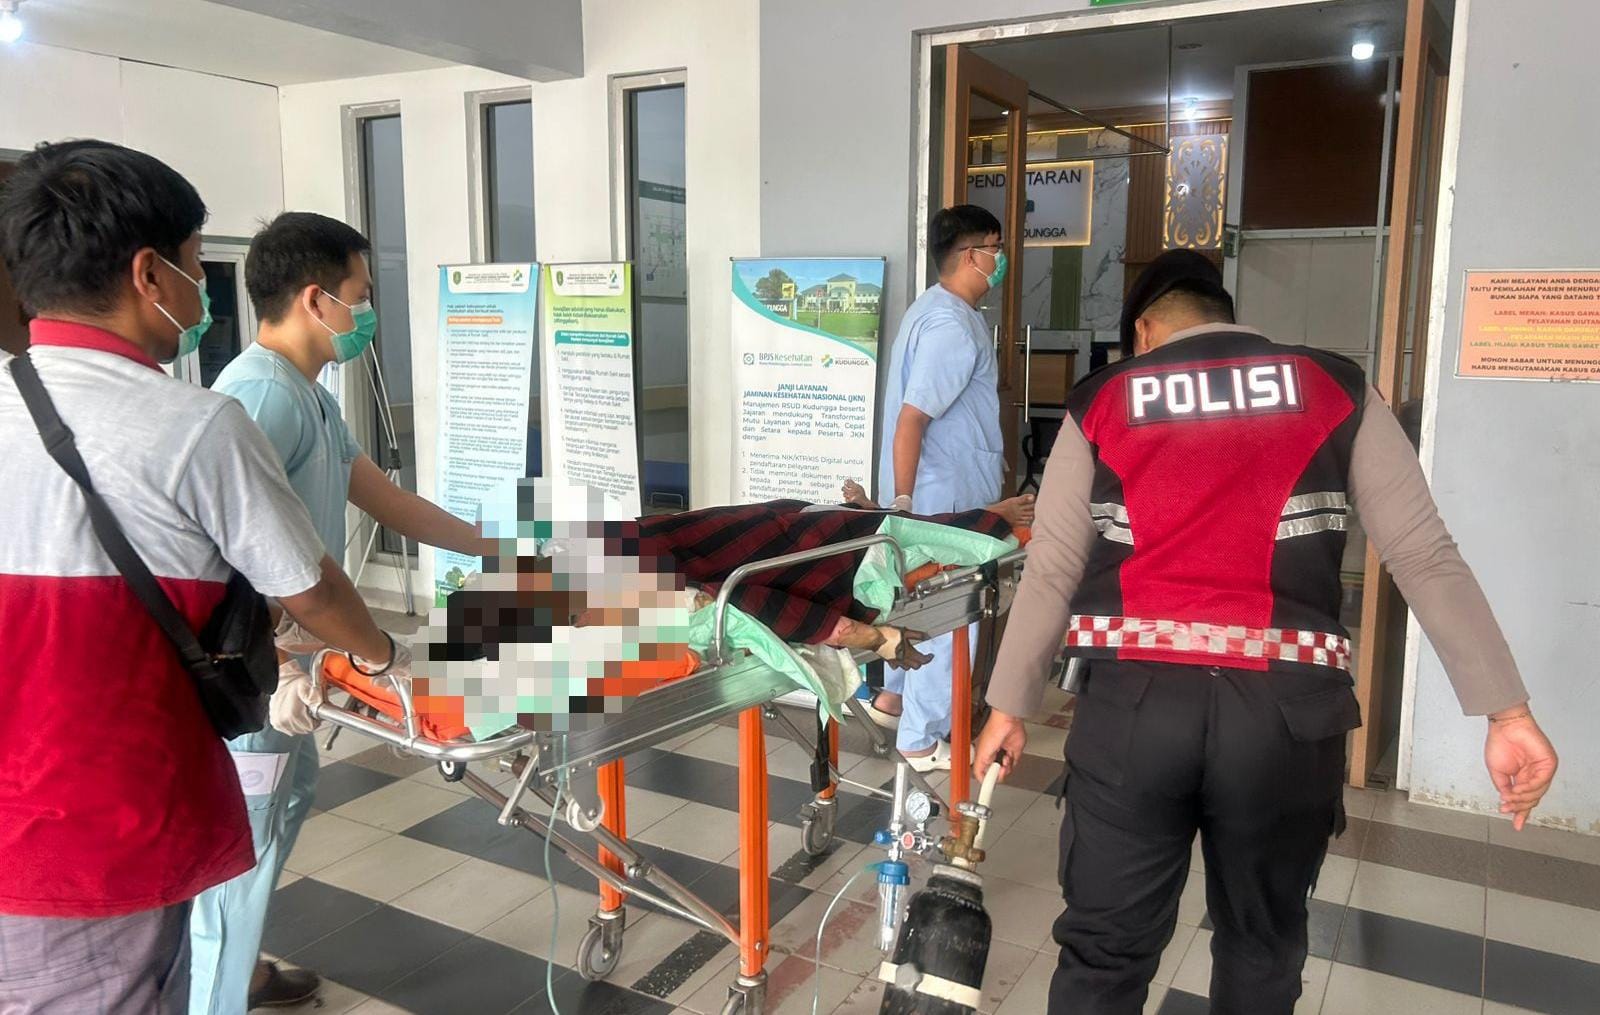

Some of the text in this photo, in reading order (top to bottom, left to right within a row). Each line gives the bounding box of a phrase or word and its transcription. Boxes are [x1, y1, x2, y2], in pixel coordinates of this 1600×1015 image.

[967, 169, 1082, 188] PENDTARAN
[774, 353, 813, 362] Kesehatan
[777, 383, 828, 392] JANJI LAYANAN
[1131, 363, 1298, 418] POLISI
[773, 391, 811, 400] KESEHATAN
[811, 393, 846, 401] NASIONAL
[847, 394, 866, 402] (JKN)
[743, 401, 866, 412] Manajemen RSUD Kudungga beserta
[772, 411, 813, 419] mendukung
[821, 412, 866, 420] Transformasi
[763, 418, 790, 427] Layanan
[815, 421, 840, 429] Mudah,
[844, 422, 865, 430] Cepat
[787, 428, 812, 436] kepada
[742, 434, 767, 442] dengan
[750, 460, 820, 471] pendaftaran pelayanan
[820, 456, 842, 465] Digital
[844, 457, 864, 465] untuk
[801, 471, 832, 479] dokumen
[749, 477, 771, 485] kepada
[810, 480, 835, 489] sebagai
[749, 485, 819, 495] pendaftaran pelayanan
